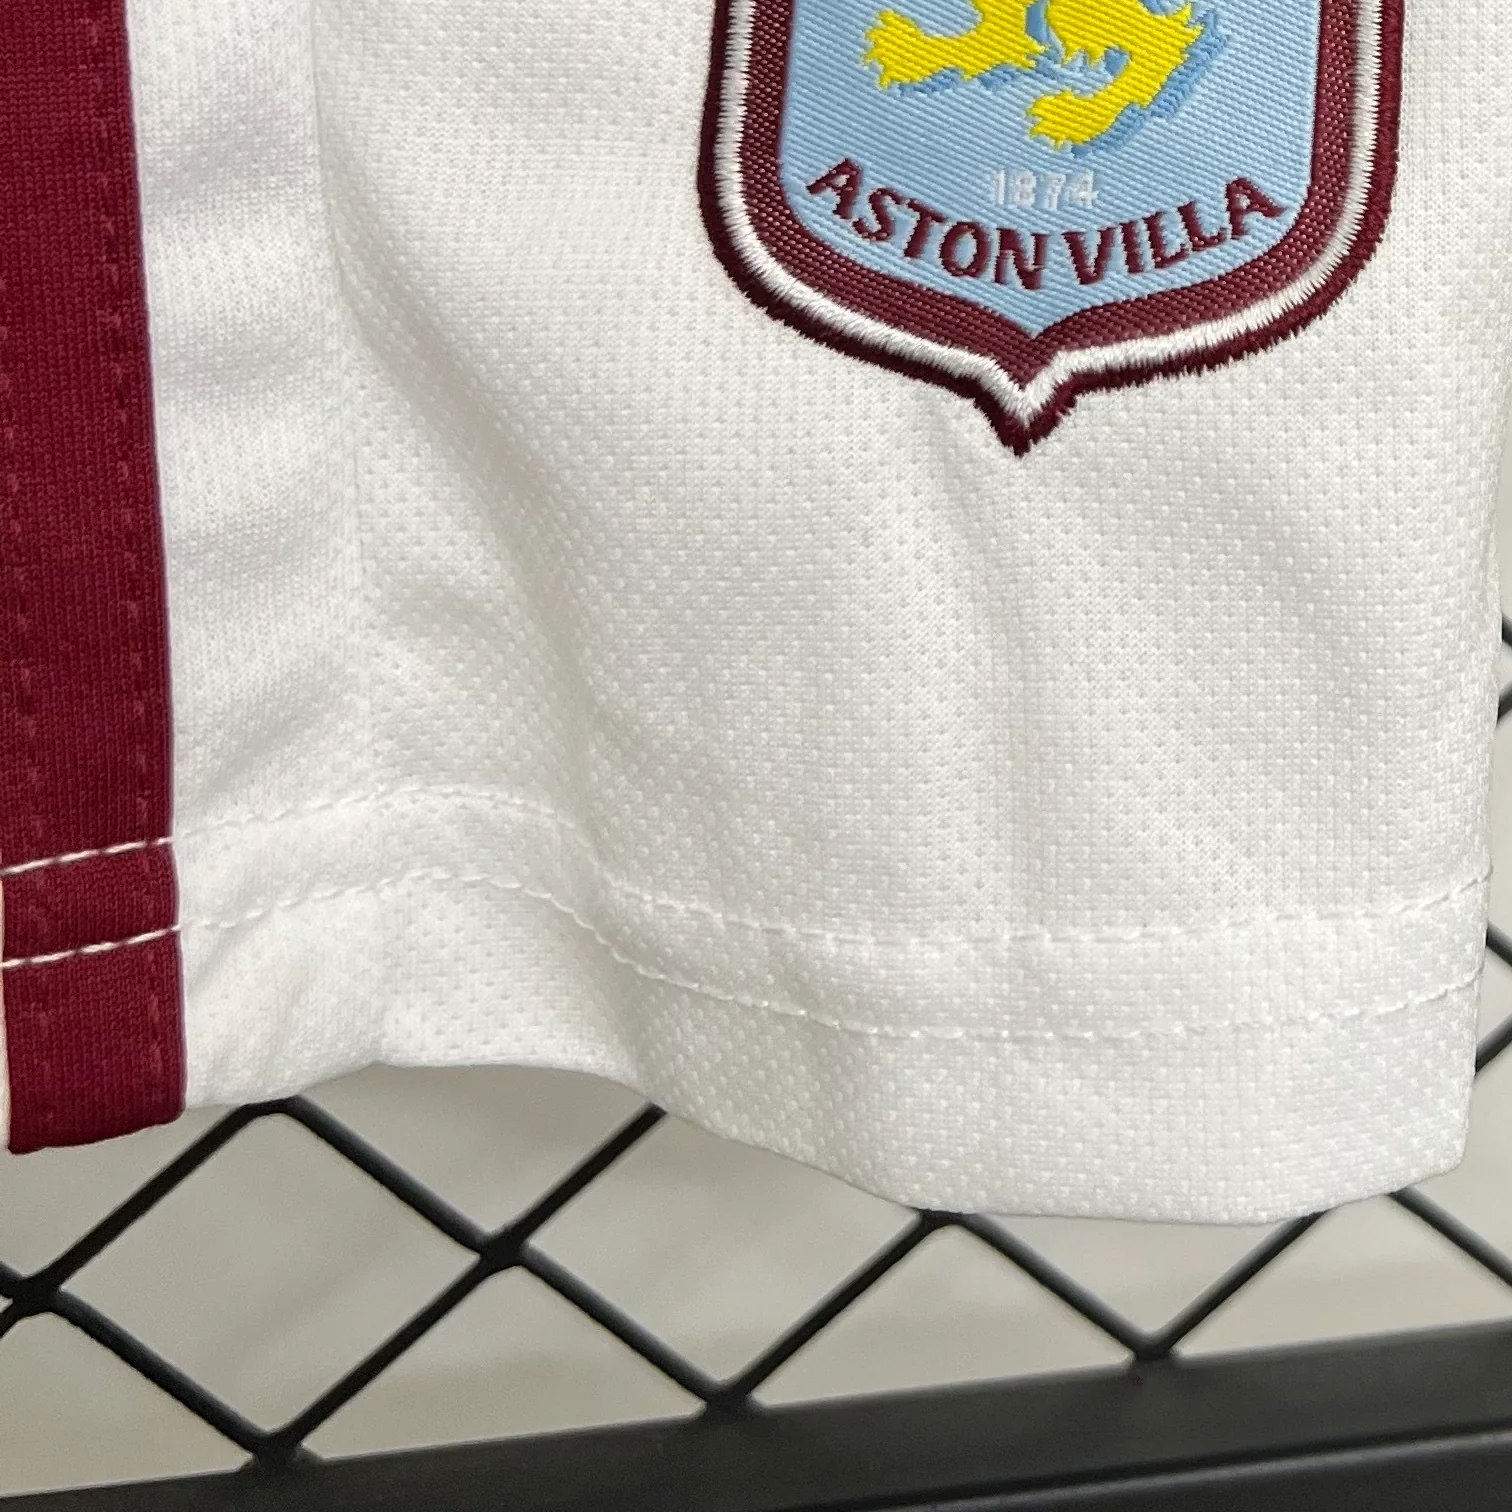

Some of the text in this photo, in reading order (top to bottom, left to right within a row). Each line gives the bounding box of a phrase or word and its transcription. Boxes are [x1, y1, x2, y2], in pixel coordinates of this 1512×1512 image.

[806, 158, 1286, 290] ASTON VILLA
[993, 169, 1099, 209] 1874
